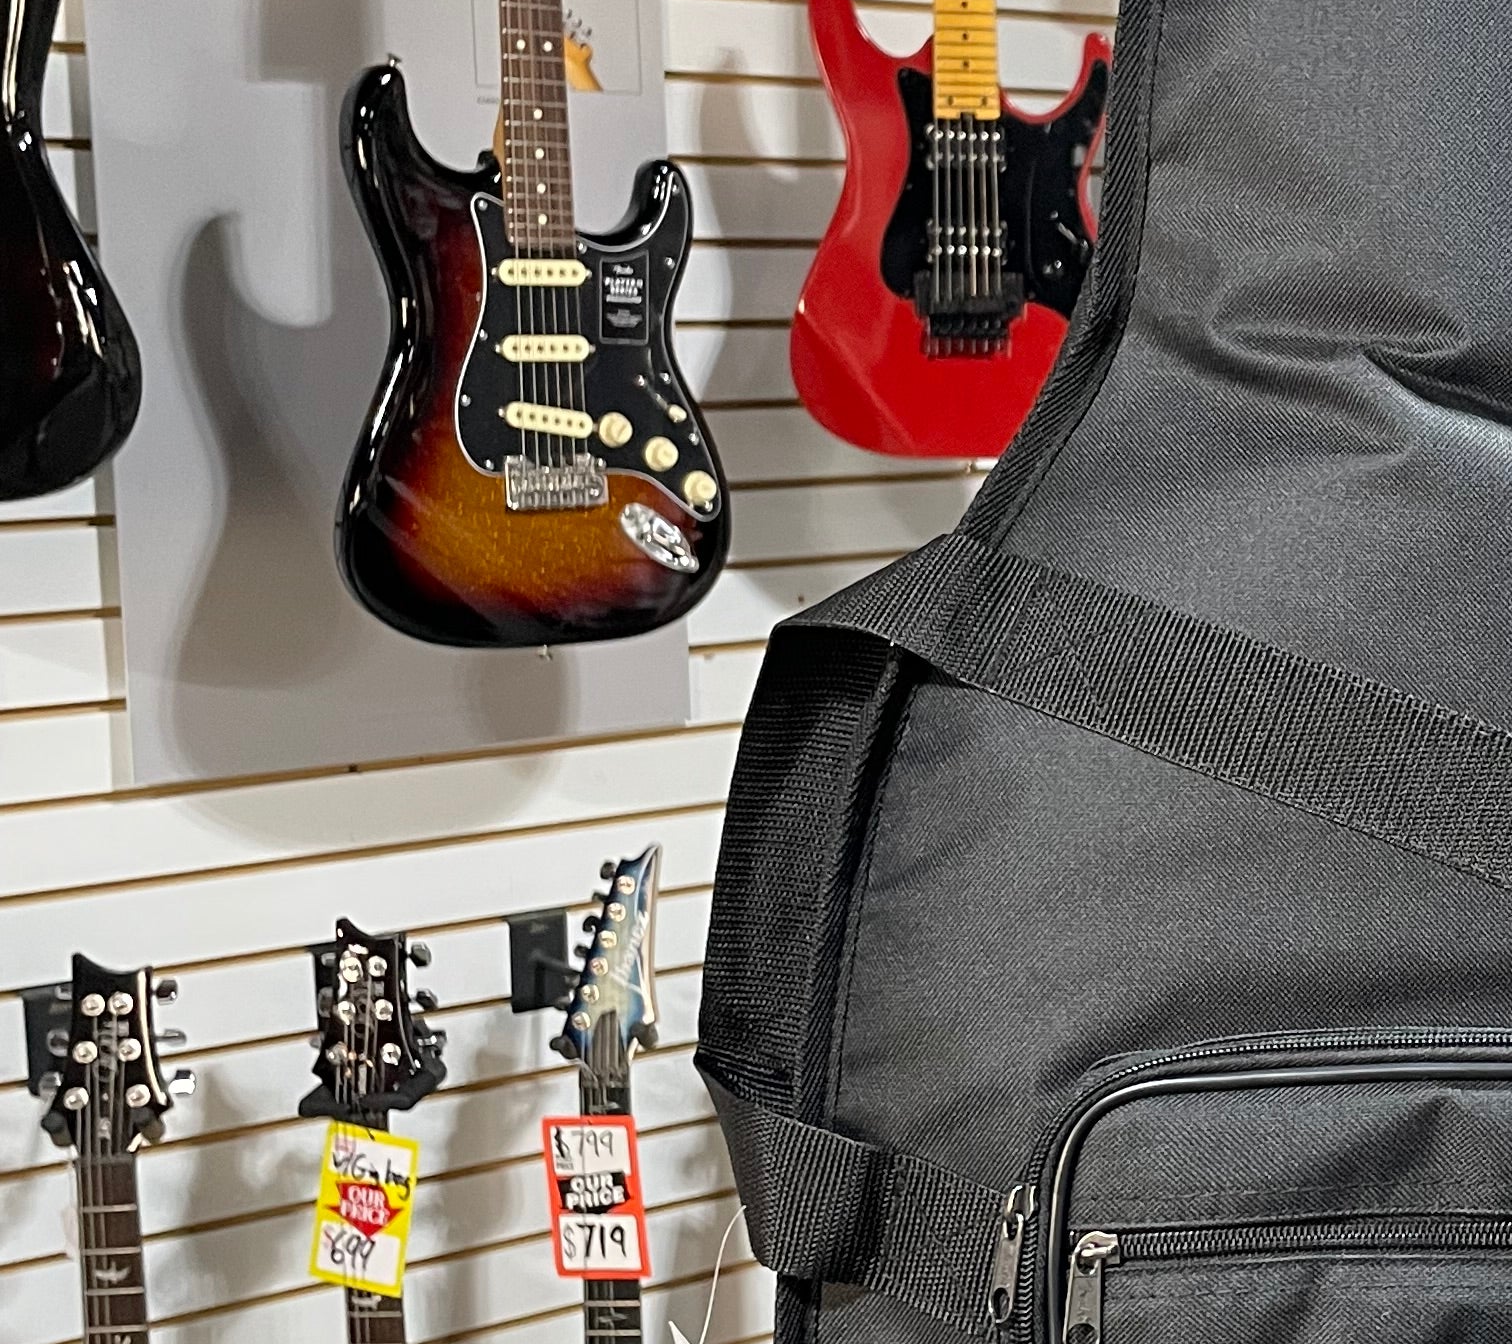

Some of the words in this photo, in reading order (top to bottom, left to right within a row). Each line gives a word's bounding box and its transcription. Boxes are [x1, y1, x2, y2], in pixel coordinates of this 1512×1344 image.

[348, 1184, 385, 1206] OUR
[570, 1175, 614, 1193] OUR
[565, 1186, 625, 1210] PRICE
[340, 1200, 391, 1225] PRICE
[564, 1223, 627, 1260] $719
